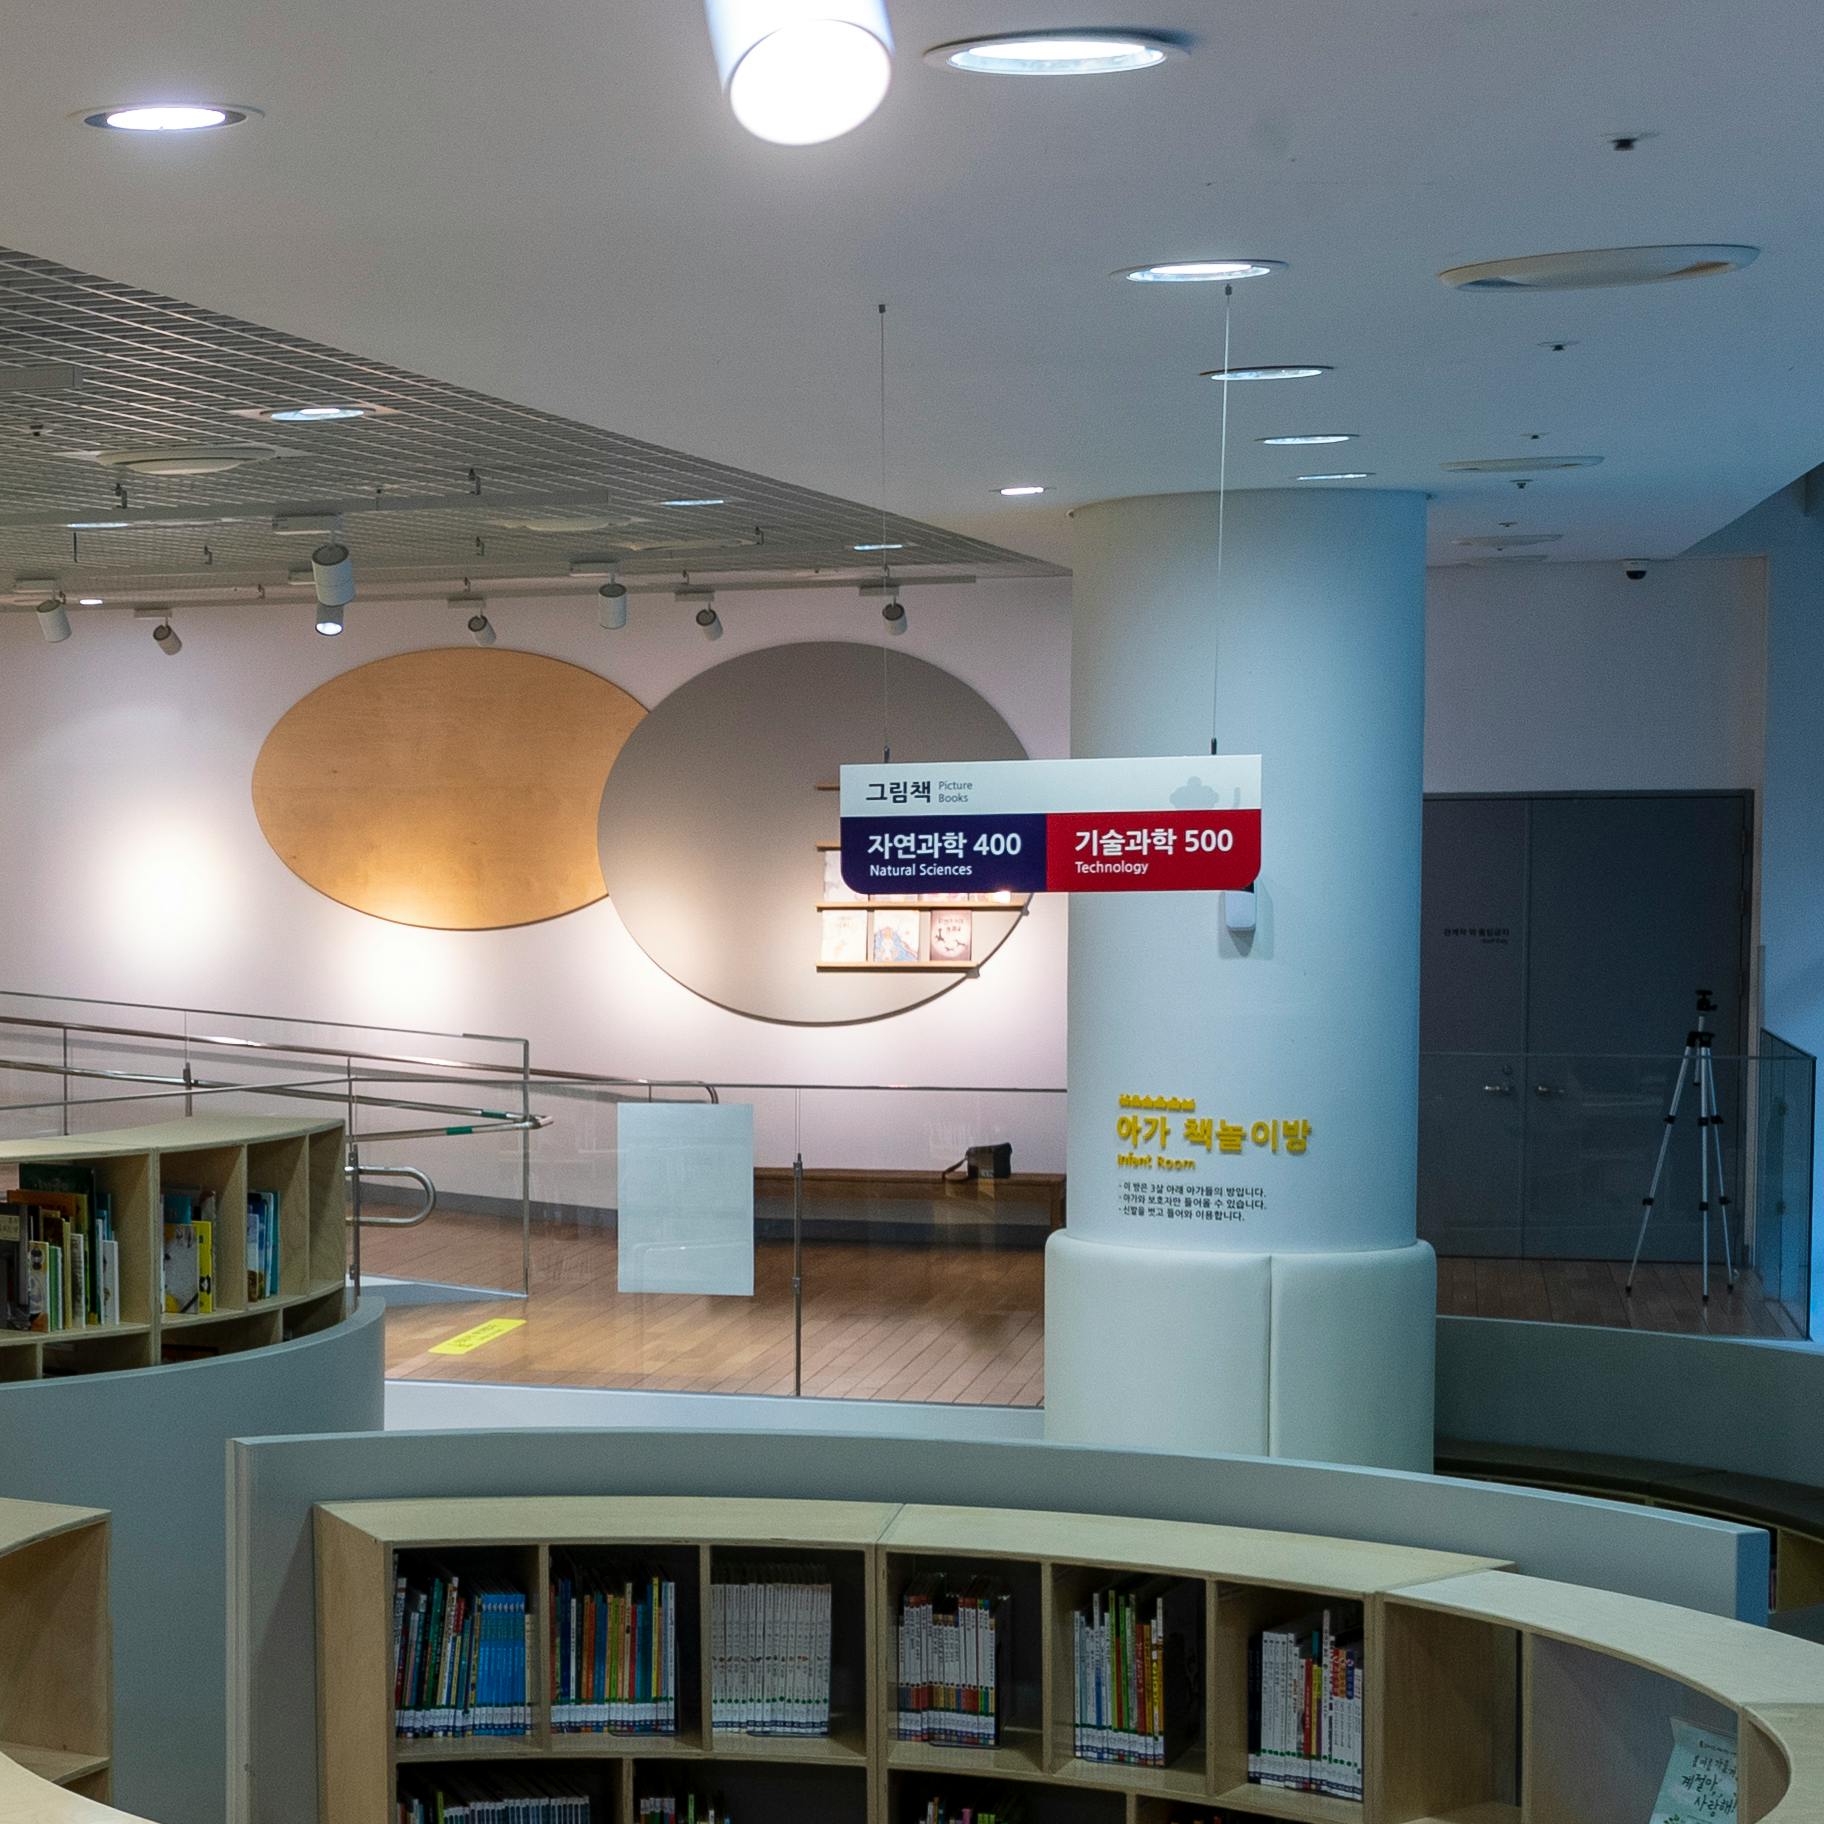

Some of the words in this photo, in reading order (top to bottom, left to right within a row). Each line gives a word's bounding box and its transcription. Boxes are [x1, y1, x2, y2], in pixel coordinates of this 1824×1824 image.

[866, 781, 931, 804] 그림책
[938, 781, 973, 791] Picture
[938, 794, 969, 803] Books
[867, 832, 968, 860] 자연과학
[973, 833, 1022, 856] 400
[1075, 828, 1177, 857] 기술과학
[1185, 829, 1234, 852] 500
[870, 863, 916, 877] Natural
[919, 863, 973, 876] Sciences
[1075, 861, 1149, 876] Technology
[1116, 1115, 1170, 1149] 아가
[1183, 1118, 1312, 1155] 책놀이방
[1117, 1152, 1152, 1169] Infant
[1157, 1155, 1196, 1170] Room
[1124, 1182, 1131, 1191] 이
[1133, 1182, 1148, 1192] 방은
[1166, 1184, 1184, 1195] 아래
[1186, 1185, 1223, 1197] 아가들의
[1226, 1187, 1266, 1198] 방입니다.
[1123, 1194, 1146, 1204] 아가와
[1148, 1195, 1181, 1207] 보호자만
[1214, 1198, 1223, 1208] 수
[1226, 1199, 1267, 1211] 있습니다.
[1123, 1205, 1145, 1216] 신발을
[1166, 1208, 1193, 1219] 들어와
[1195, 1209, 1245, 1222] 이용합니다.
[1694, 1793, 1737, 1818] 사랑해!
